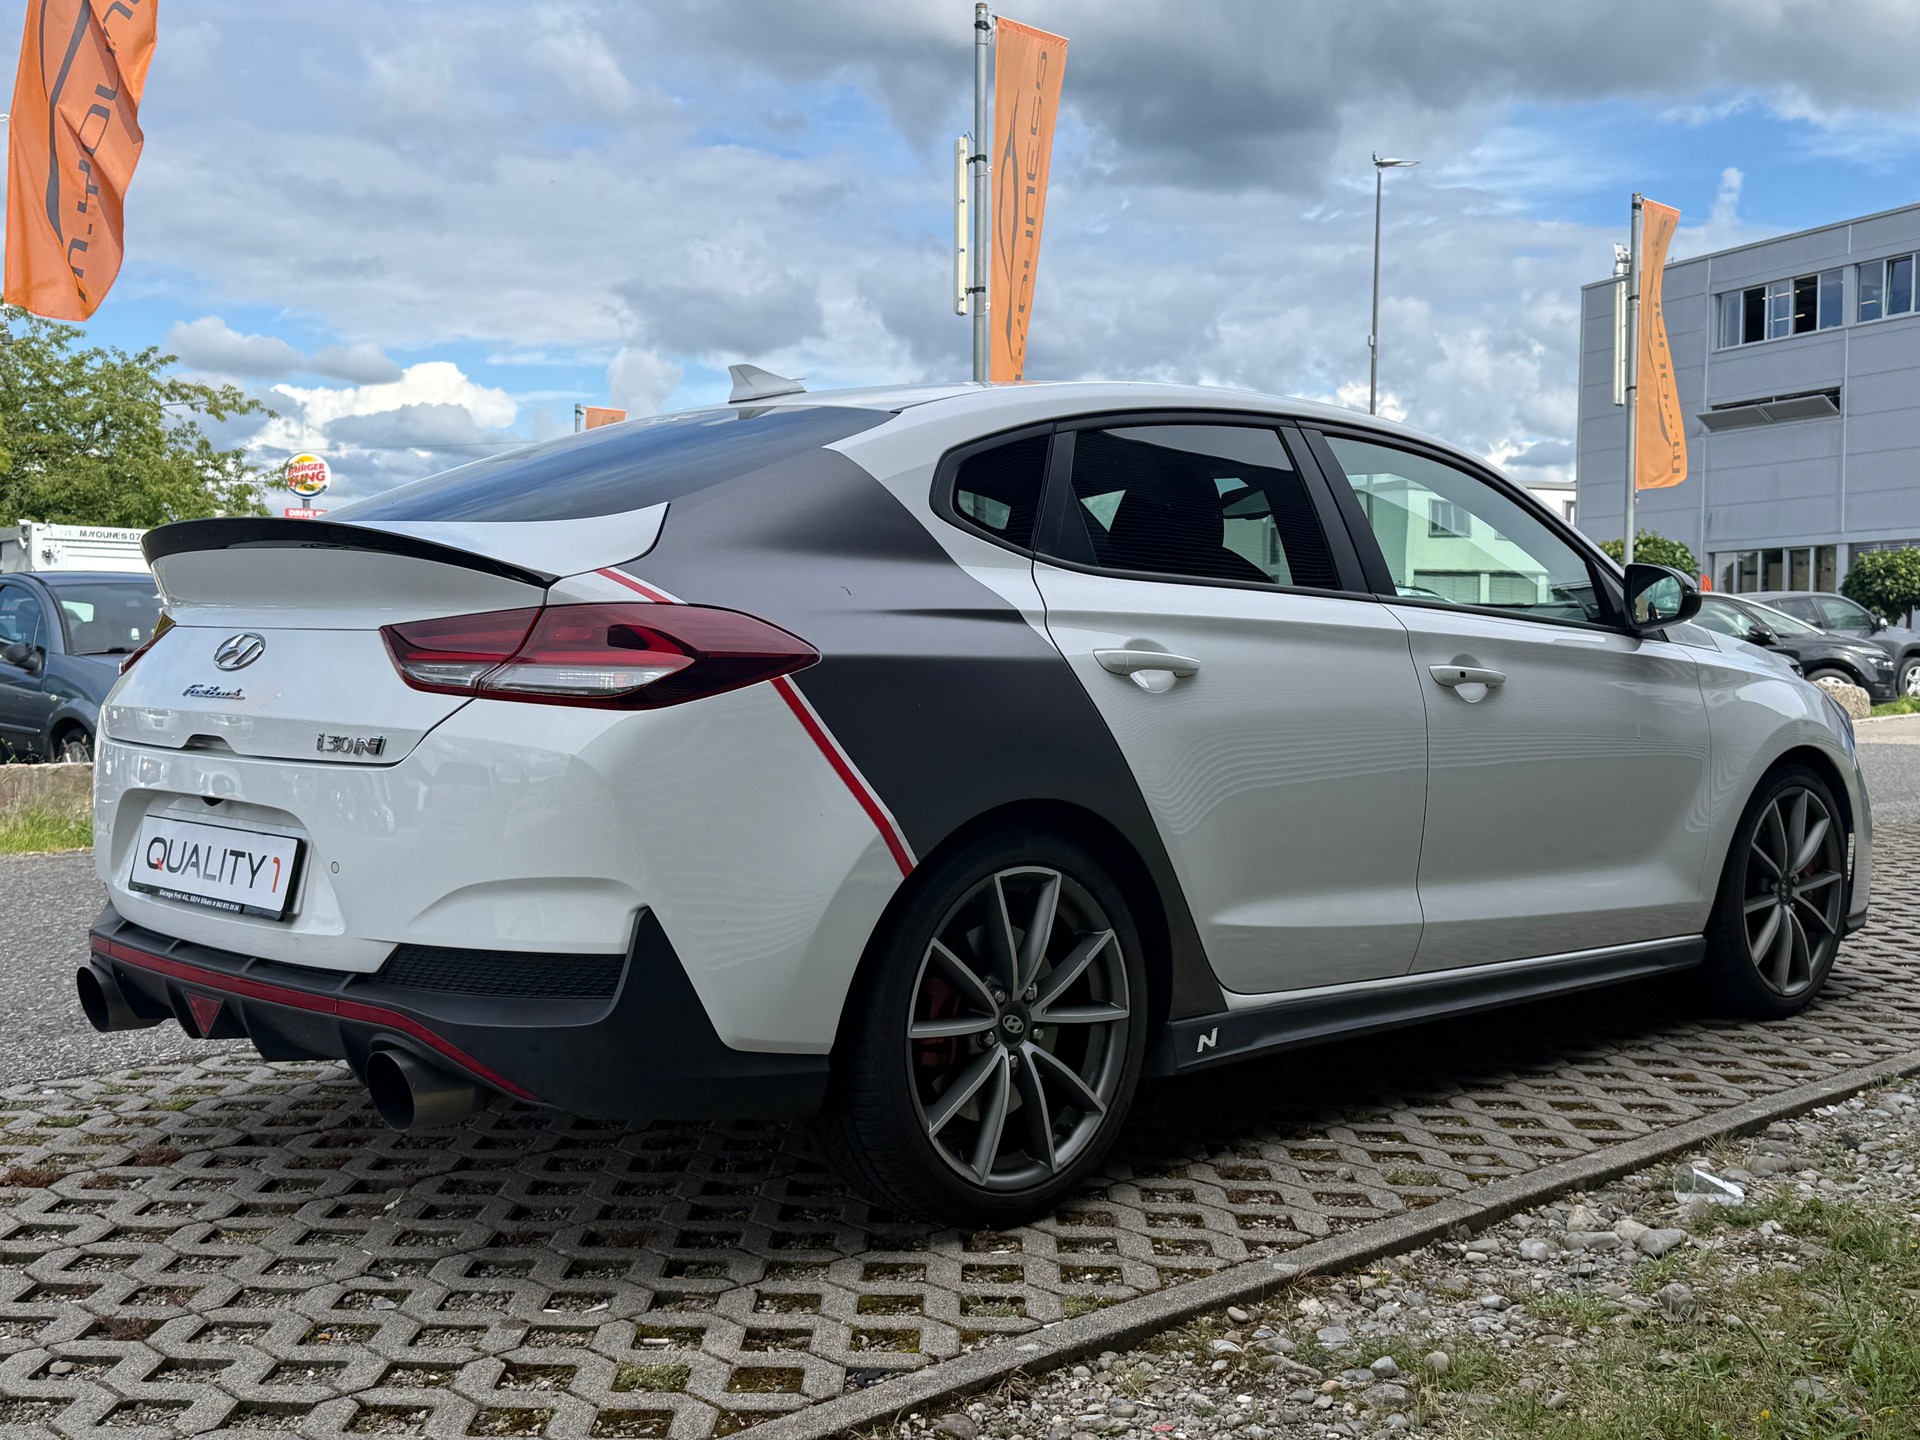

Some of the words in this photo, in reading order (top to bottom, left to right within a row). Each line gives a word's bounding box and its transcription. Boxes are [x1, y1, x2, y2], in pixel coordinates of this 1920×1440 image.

[67, 0, 140, 303] m.youn
[288, 509, 314, 518] DRIVE
[147, 837, 268, 889] QUALITY
[272, 857, 281, 893] 1
[159, 889, 174, 899] Garage
[1197, 1027, 1218, 1053] N
